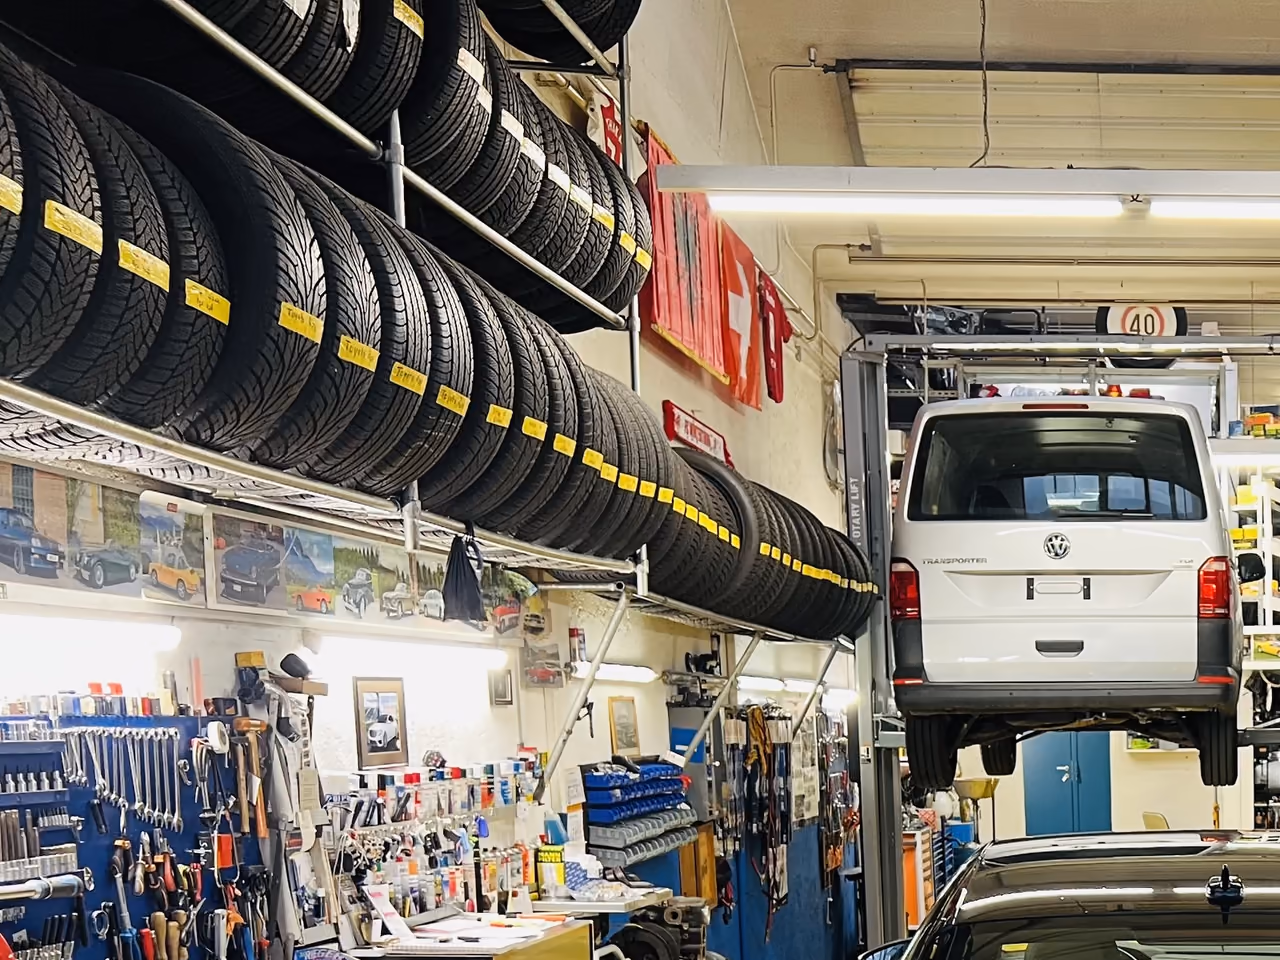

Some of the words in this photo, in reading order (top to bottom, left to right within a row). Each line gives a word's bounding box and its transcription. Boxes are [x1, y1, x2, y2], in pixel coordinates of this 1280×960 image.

[1129, 313, 1155, 335] 40
[850, 502, 862, 546] OTARY
[922, 557, 988, 565] TRANSPORTER
